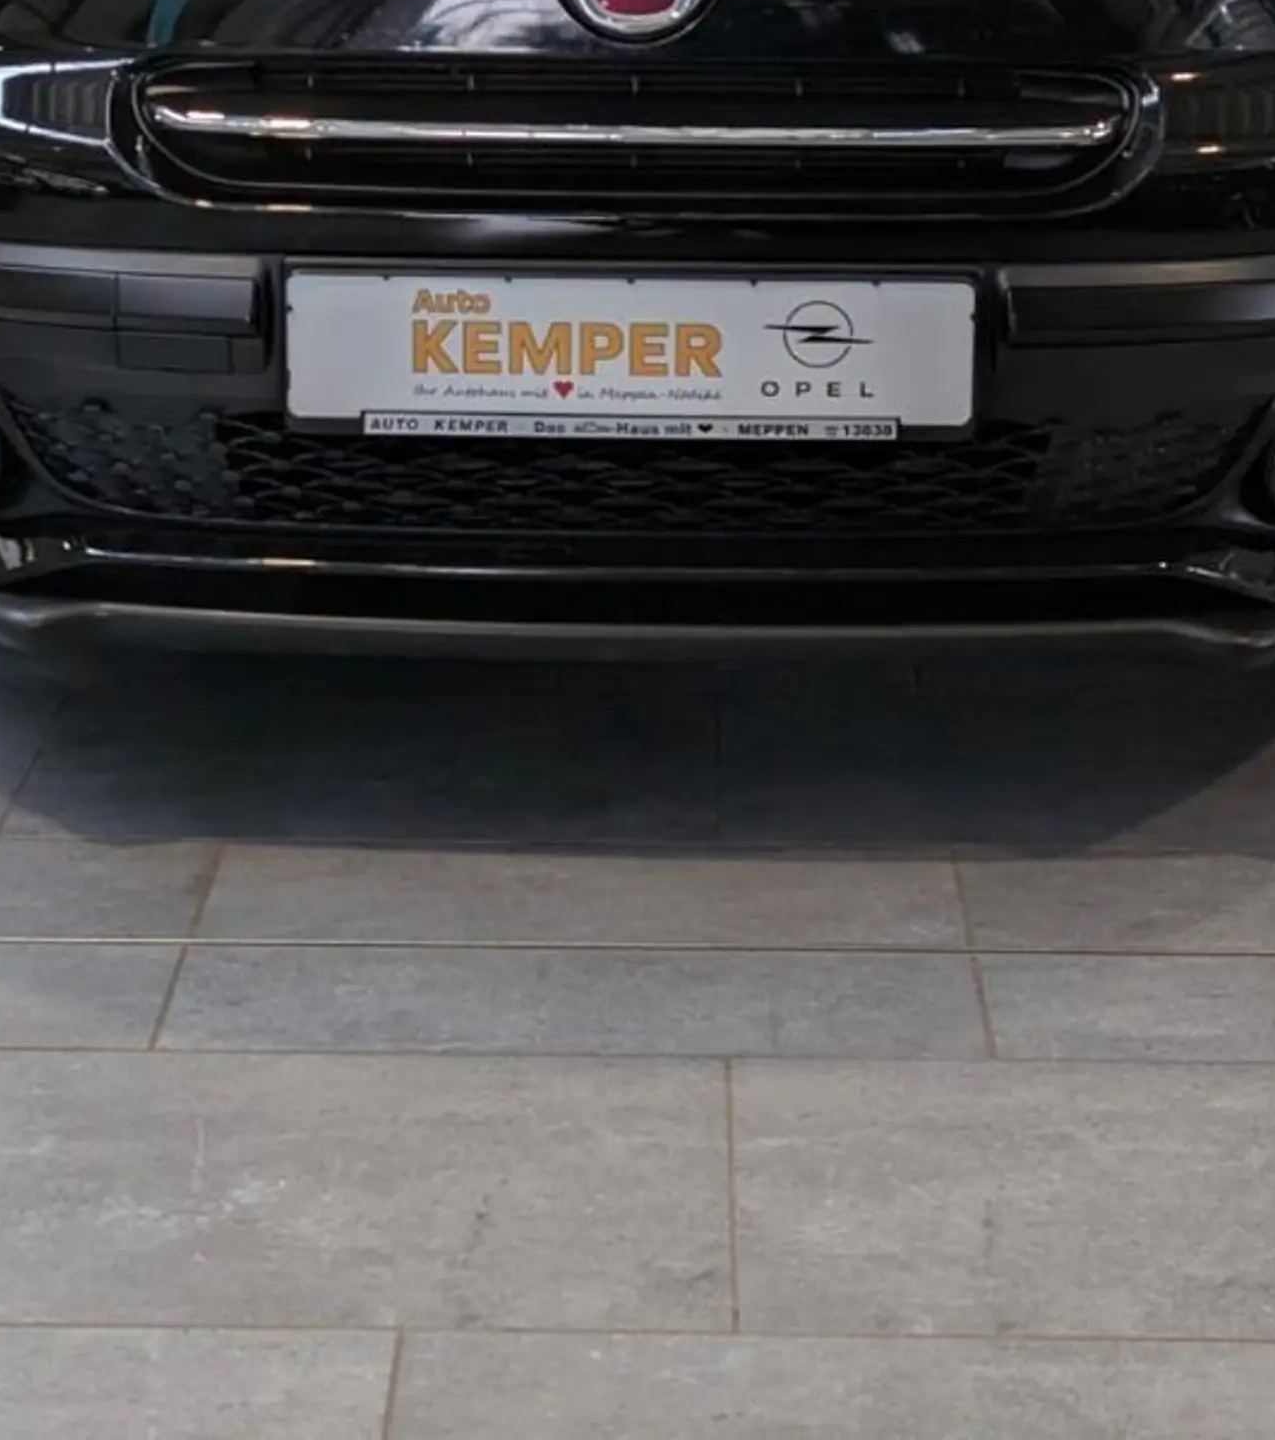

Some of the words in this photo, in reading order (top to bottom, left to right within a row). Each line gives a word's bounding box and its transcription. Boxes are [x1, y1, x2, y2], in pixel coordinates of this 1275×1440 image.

[412, 288, 492, 314] Auto
[411, 318, 724, 378] KEMPER
[760, 381, 875, 398] OPEL
[370, 417, 419, 431] AUTO
[434, 419, 509, 433] KEMPER
[533, 420, 566, 434] Das
[737, 423, 809, 436] MEPPEN
